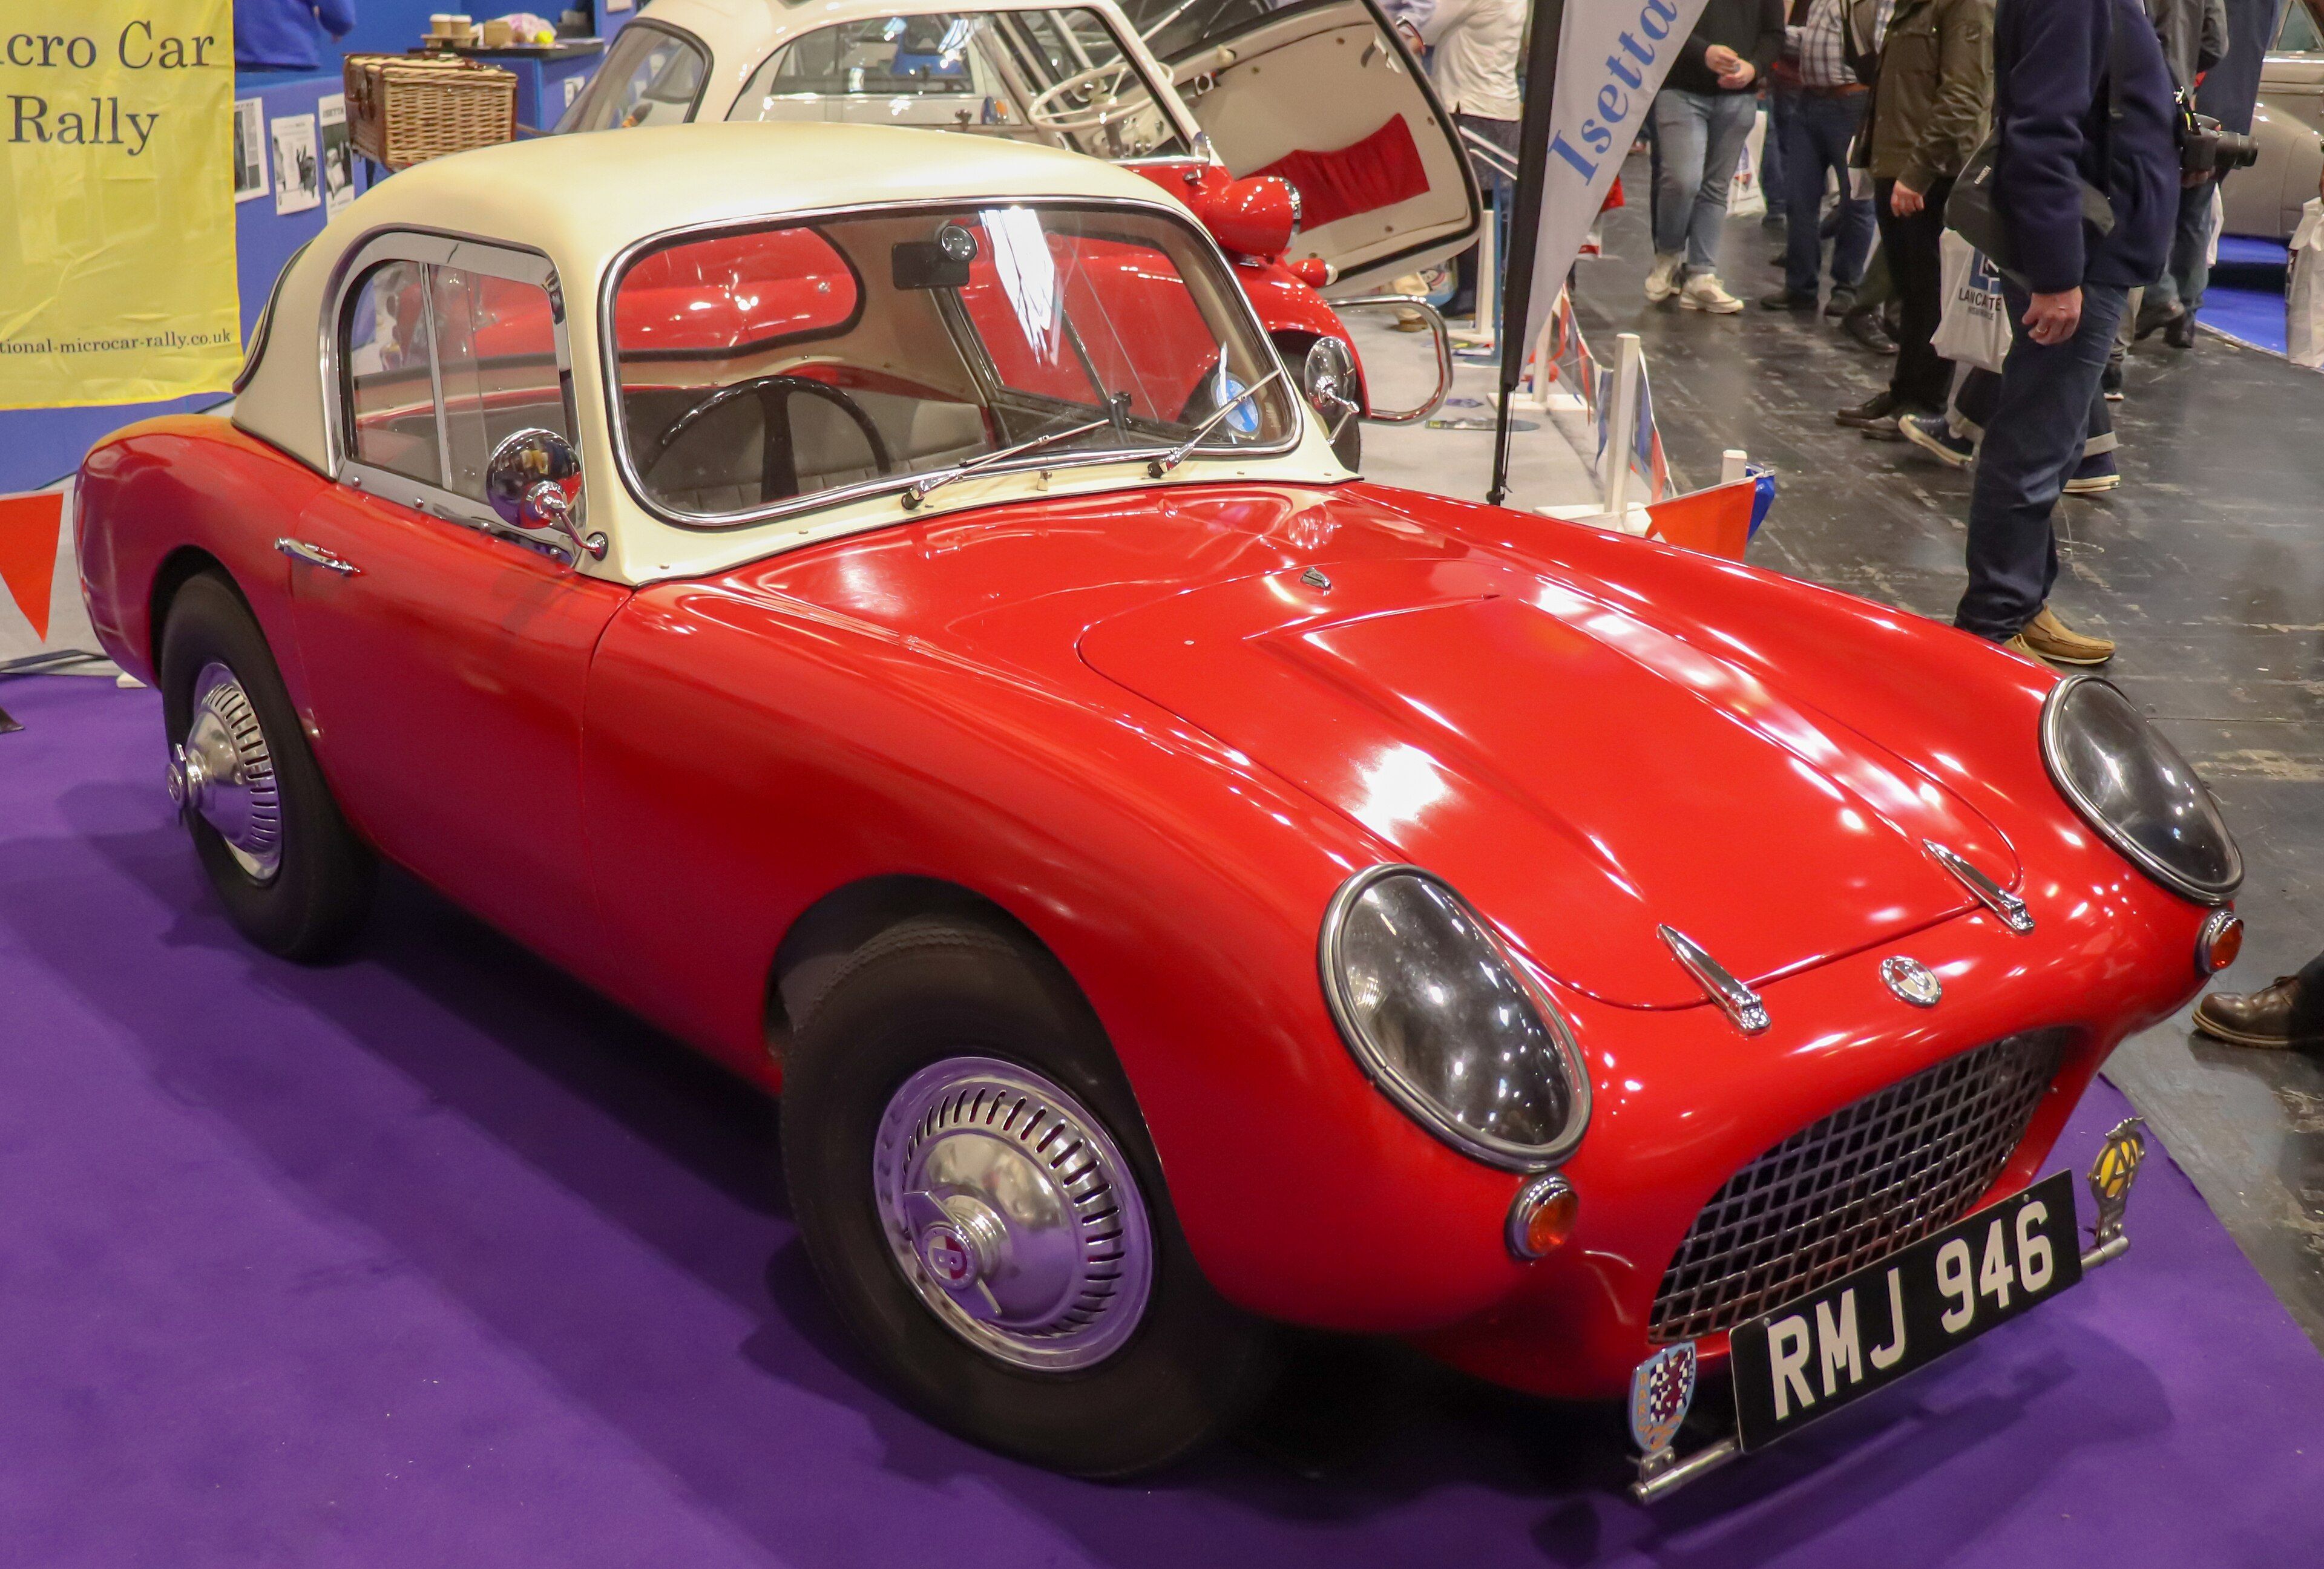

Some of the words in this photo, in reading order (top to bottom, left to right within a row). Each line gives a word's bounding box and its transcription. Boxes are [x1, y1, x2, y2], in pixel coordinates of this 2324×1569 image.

[0, 33, 97, 68] cro
[119, 20, 214, 69] Car
[1548, 0, 1678, 186] Isetta
[7, 94, 159, 156] Rally
[1767, 1268, 1905, 1420] RMJ
[1936, 1200, 2053, 1333] 946
